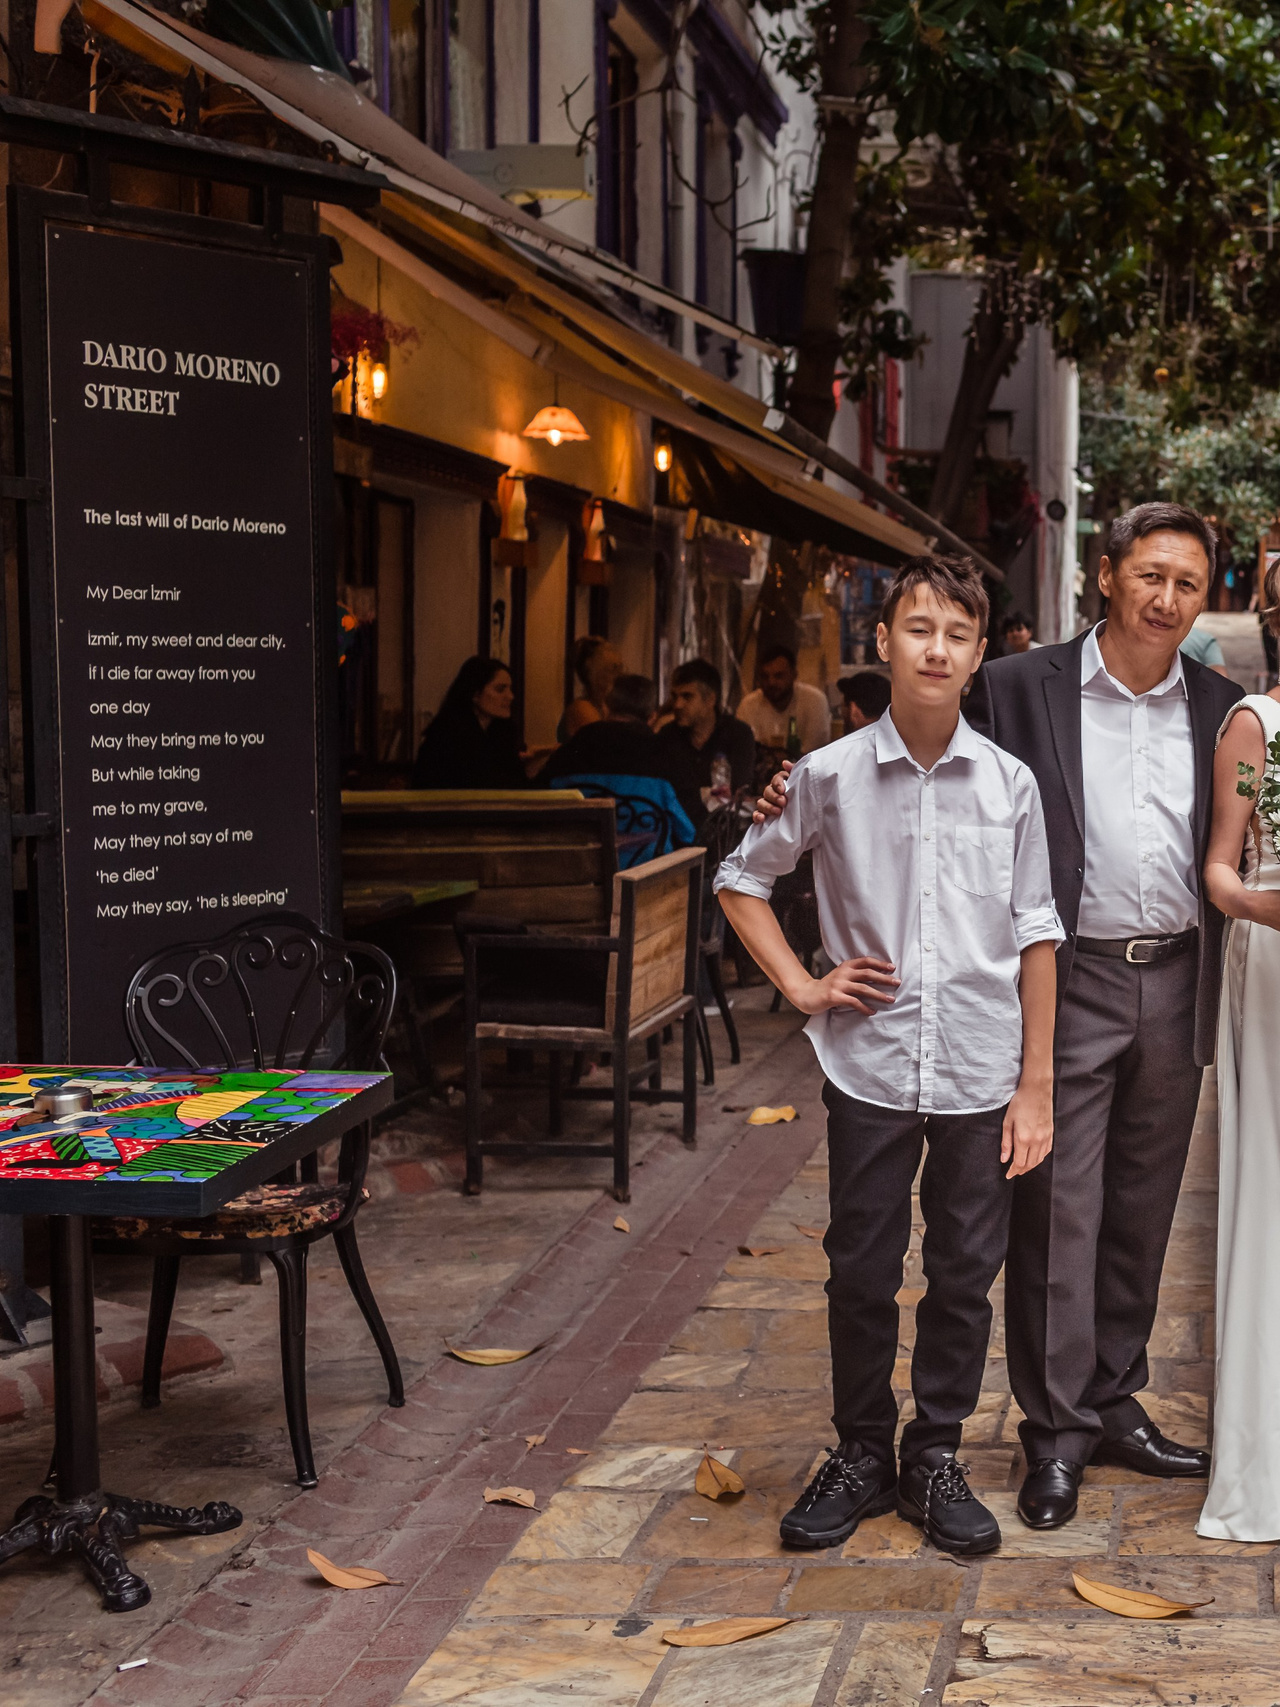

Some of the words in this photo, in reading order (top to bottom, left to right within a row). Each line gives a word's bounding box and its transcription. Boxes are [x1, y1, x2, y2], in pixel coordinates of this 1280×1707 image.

[82, 341, 167, 373] DARIO
[175, 352, 280, 386] MORENO
[84, 383, 179, 416] STREET
[84, 509, 111, 524] The
[116, 510, 142, 526] last
[146, 513, 169, 528] will
[173, 514, 188, 529] of
[192, 515, 229, 531] Dario
[233, 518, 286, 534] Moreno
[87, 585, 108, 602] My
[113, 586, 148, 600] Dear
[127, 635, 148, 649] my
[152, 633, 192, 647] sweet
[196, 634, 223, 647] and
[227, 634, 257, 648] dear
[260, 634, 285, 650] city.
[100, 666, 104, 680] I
[108, 666, 130, 680] die
[134, 666, 153, 679] far
[156, 669, 195, 682] away
[199, 666, 228, 680] from
[231, 669, 255, 682] you
[90, 702, 118, 714] one
[122, 700, 150, 716] day
[91, 735, 123, 750] May
[127, 734, 157, 750] they
[161, 732, 195, 749] bring
[199, 734, 221, 746] me
[224, 732, 237, 745] to
[241, 733, 264, 747] you
[92, 768, 114, 782] But
[118, 767, 154, 781] while
[158, 765, 200, 782] taking
[93, 804, 116, 816] me
[120, 801, 135, 815] to
[139, 803, 160, 817] my
[164, 800, 207, 817] grave,
[94, 837, 126, 851] May
[130, 834, 161, 849] they
[164, 831, 186, 846] not
[190, 832, 212, 846] say
[215, 828, 228, 843] of
[232, 830, 253, 842] me
[97, 903, 130, 918] May
[132, 901, 163, 916] they
[166, 900, 192, 913] say,
[221, 893, 229, 907] is
